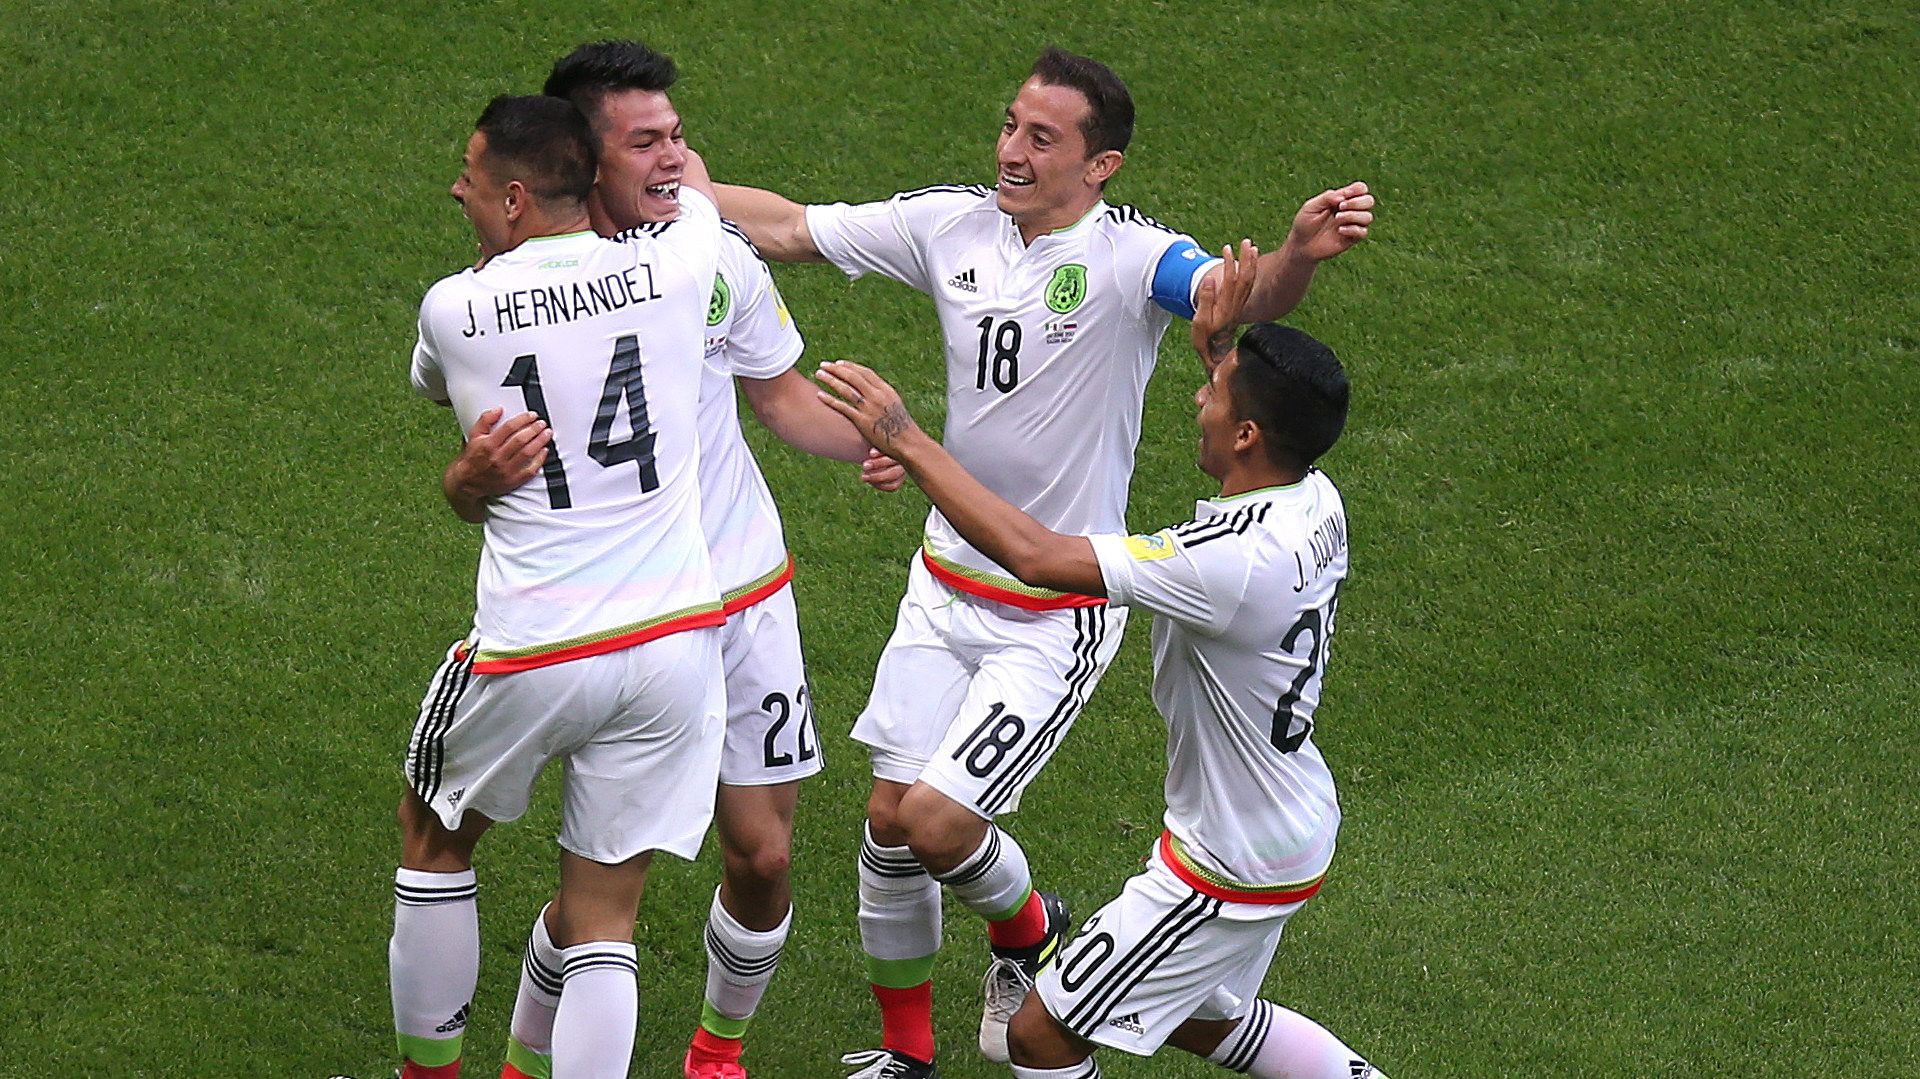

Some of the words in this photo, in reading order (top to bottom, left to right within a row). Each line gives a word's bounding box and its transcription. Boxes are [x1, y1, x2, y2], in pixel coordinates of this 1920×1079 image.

[462, 300, 485, 338] J.
[495, 263, 662, 334] HERNANDEZ
[975, 316, 1022, 393] 18
[501, 334, 660, 510] 14
[1293, 551, 1309, 593] J.
[1308, 511, 1346, 579] AQUIN
[1271, 598, 1336, 754] 2
[761, 684, 816, 767] 22
[951, 702, 1026, 778] 18
[1110, 1019, 1145, 1035] adidas
